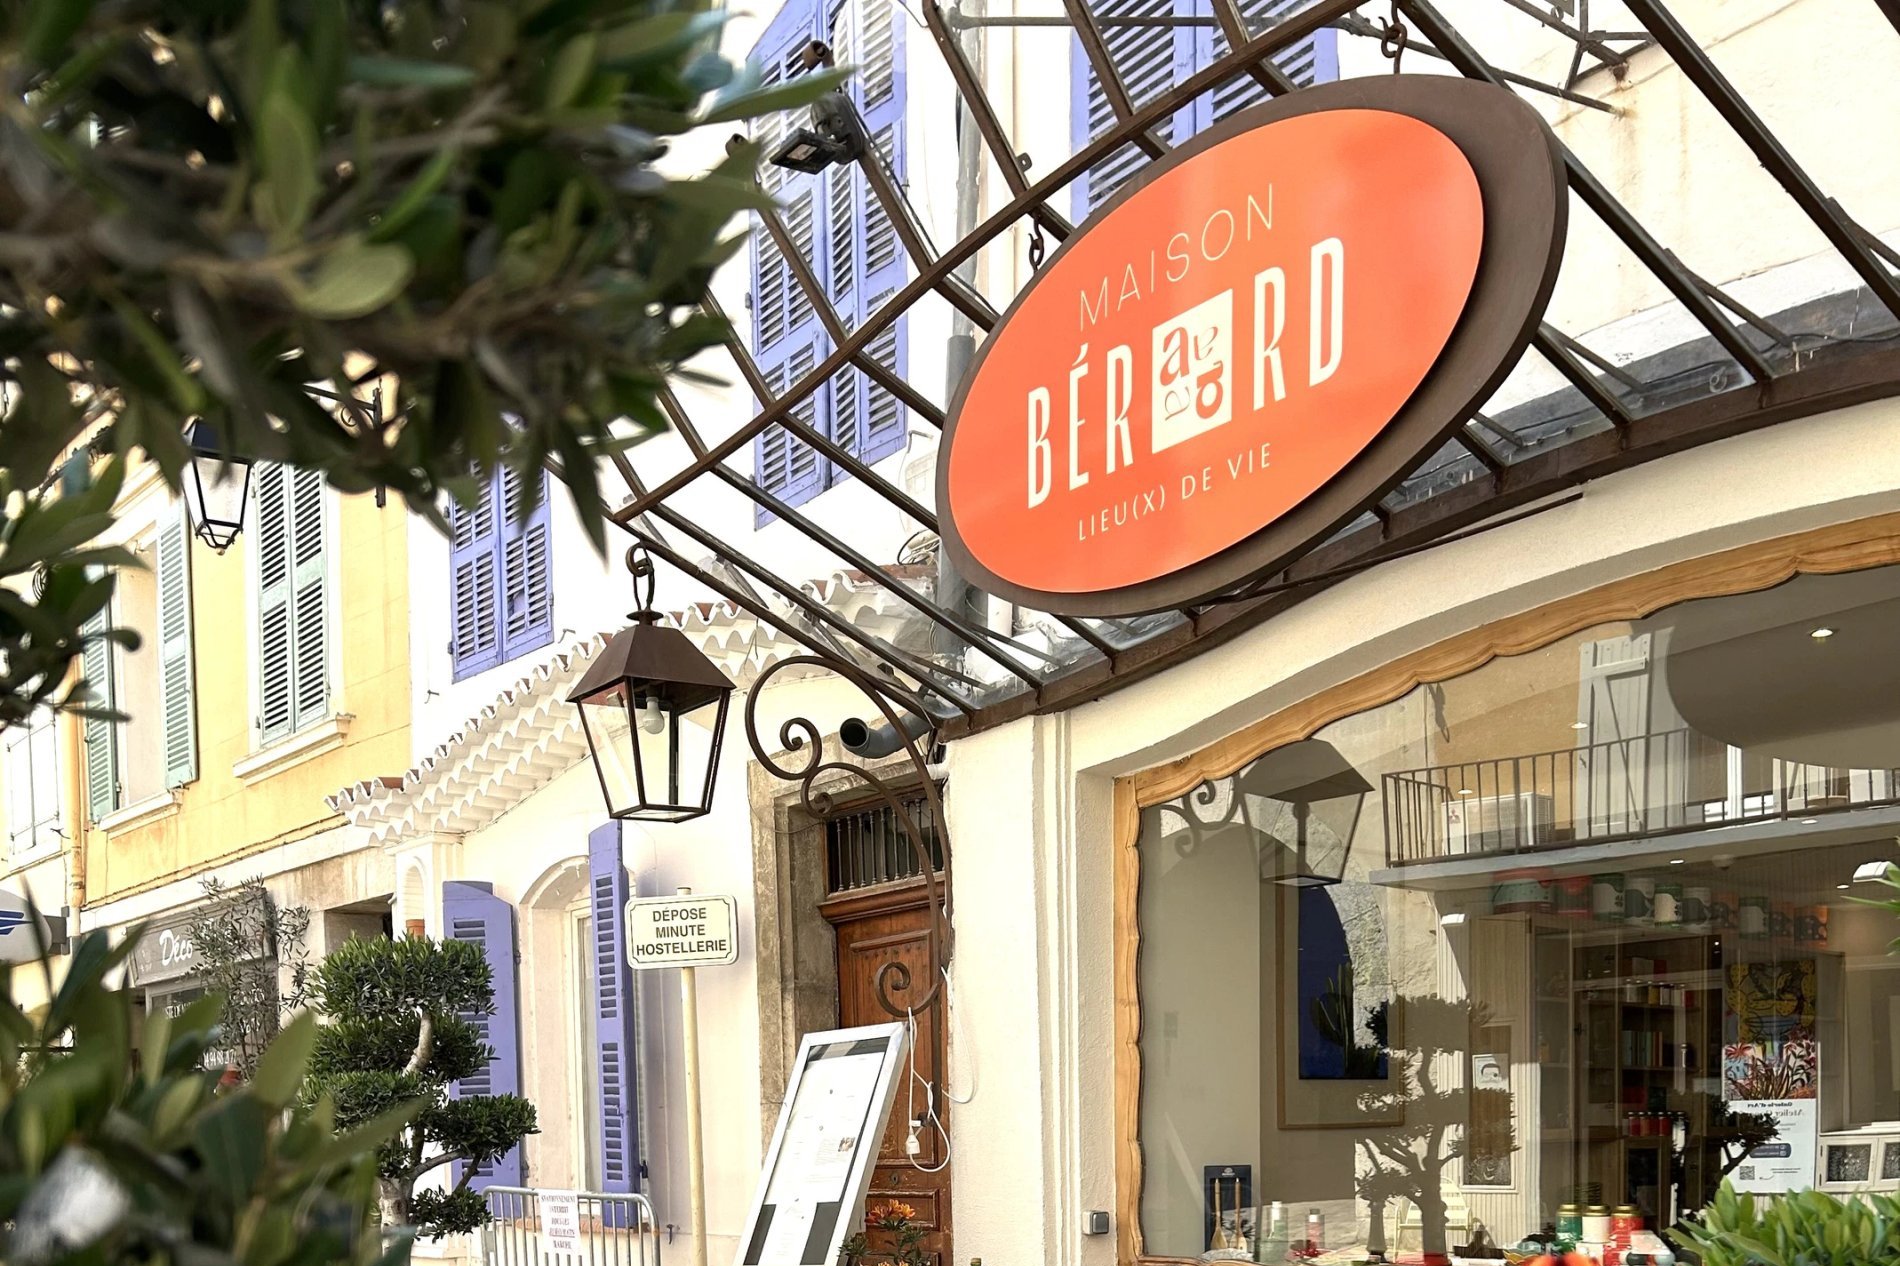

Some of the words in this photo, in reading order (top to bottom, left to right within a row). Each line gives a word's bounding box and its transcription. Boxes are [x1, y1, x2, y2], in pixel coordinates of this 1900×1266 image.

[1080, 183, 1273, 333] MAISON
[1079, 485, 1166, 541] LIEU(X)
[1181, 466, 1212, 501] DE
[1227, 442, 1271, 480] VIE
[652, 906, 707, 922] DÉPOSE
[655, 923, 706, 939] MINUTE
[159, 928, 193, 967] Déco
[636, 939, 727, 956] HOSTELLERIE
